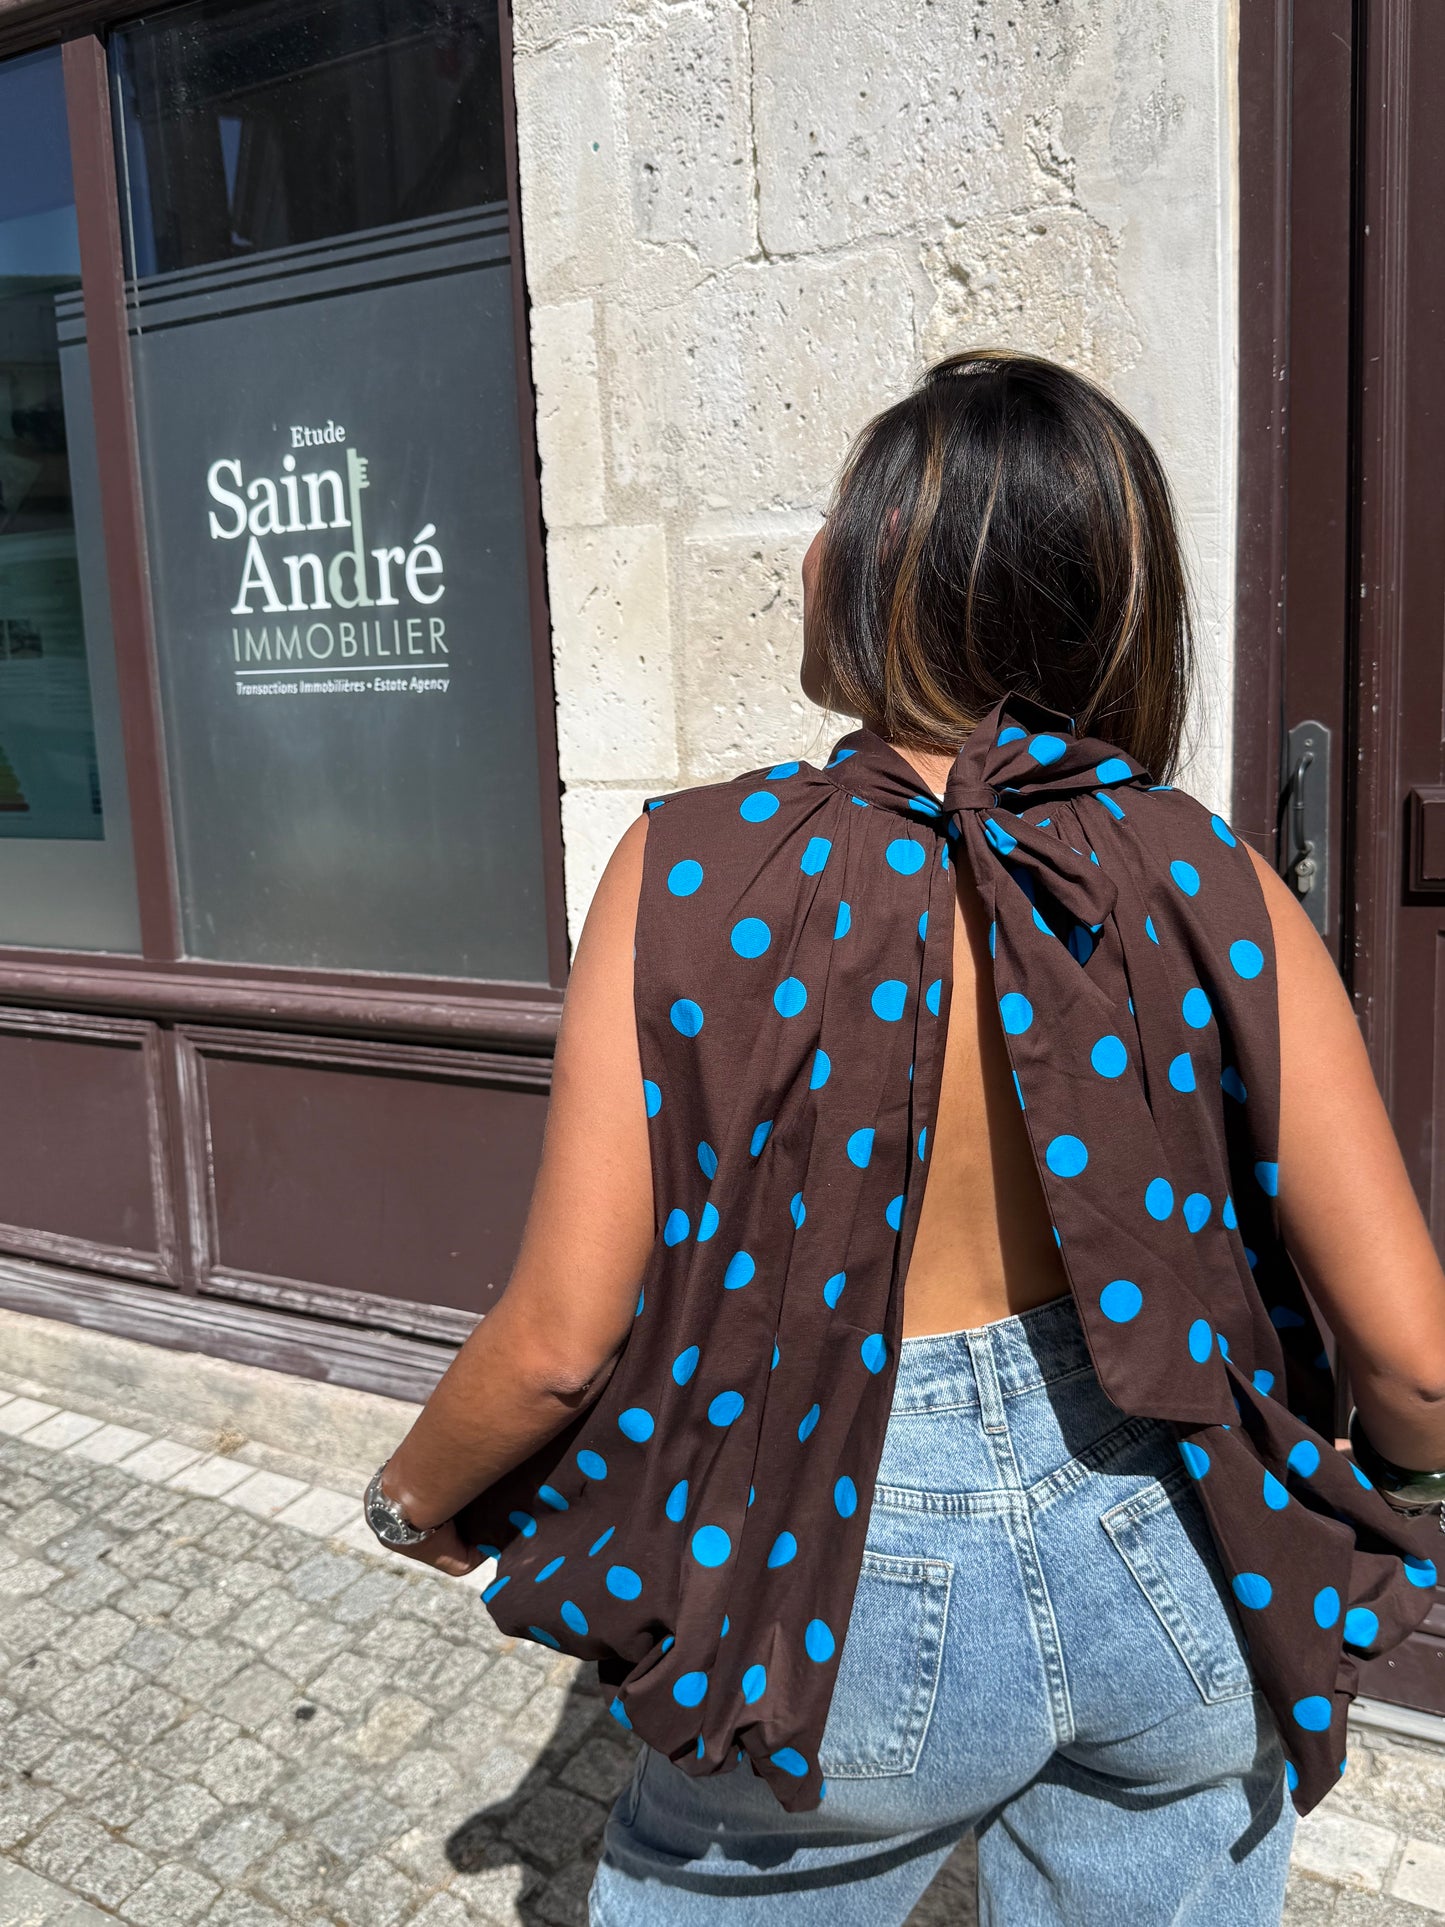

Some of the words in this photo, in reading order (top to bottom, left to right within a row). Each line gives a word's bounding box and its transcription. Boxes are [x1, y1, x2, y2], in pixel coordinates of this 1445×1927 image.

[290, 419, 346, 448] Etude
[231, 523, 446, 614] André
[232, 617, 449, 662] IMMOBILIER
[236, 680, 298, 695] Transactions
[300, 678, 365, 694] Immobilières
[374, 676, 408, 692] Estate
[409, 676, 450, 693] Agency
